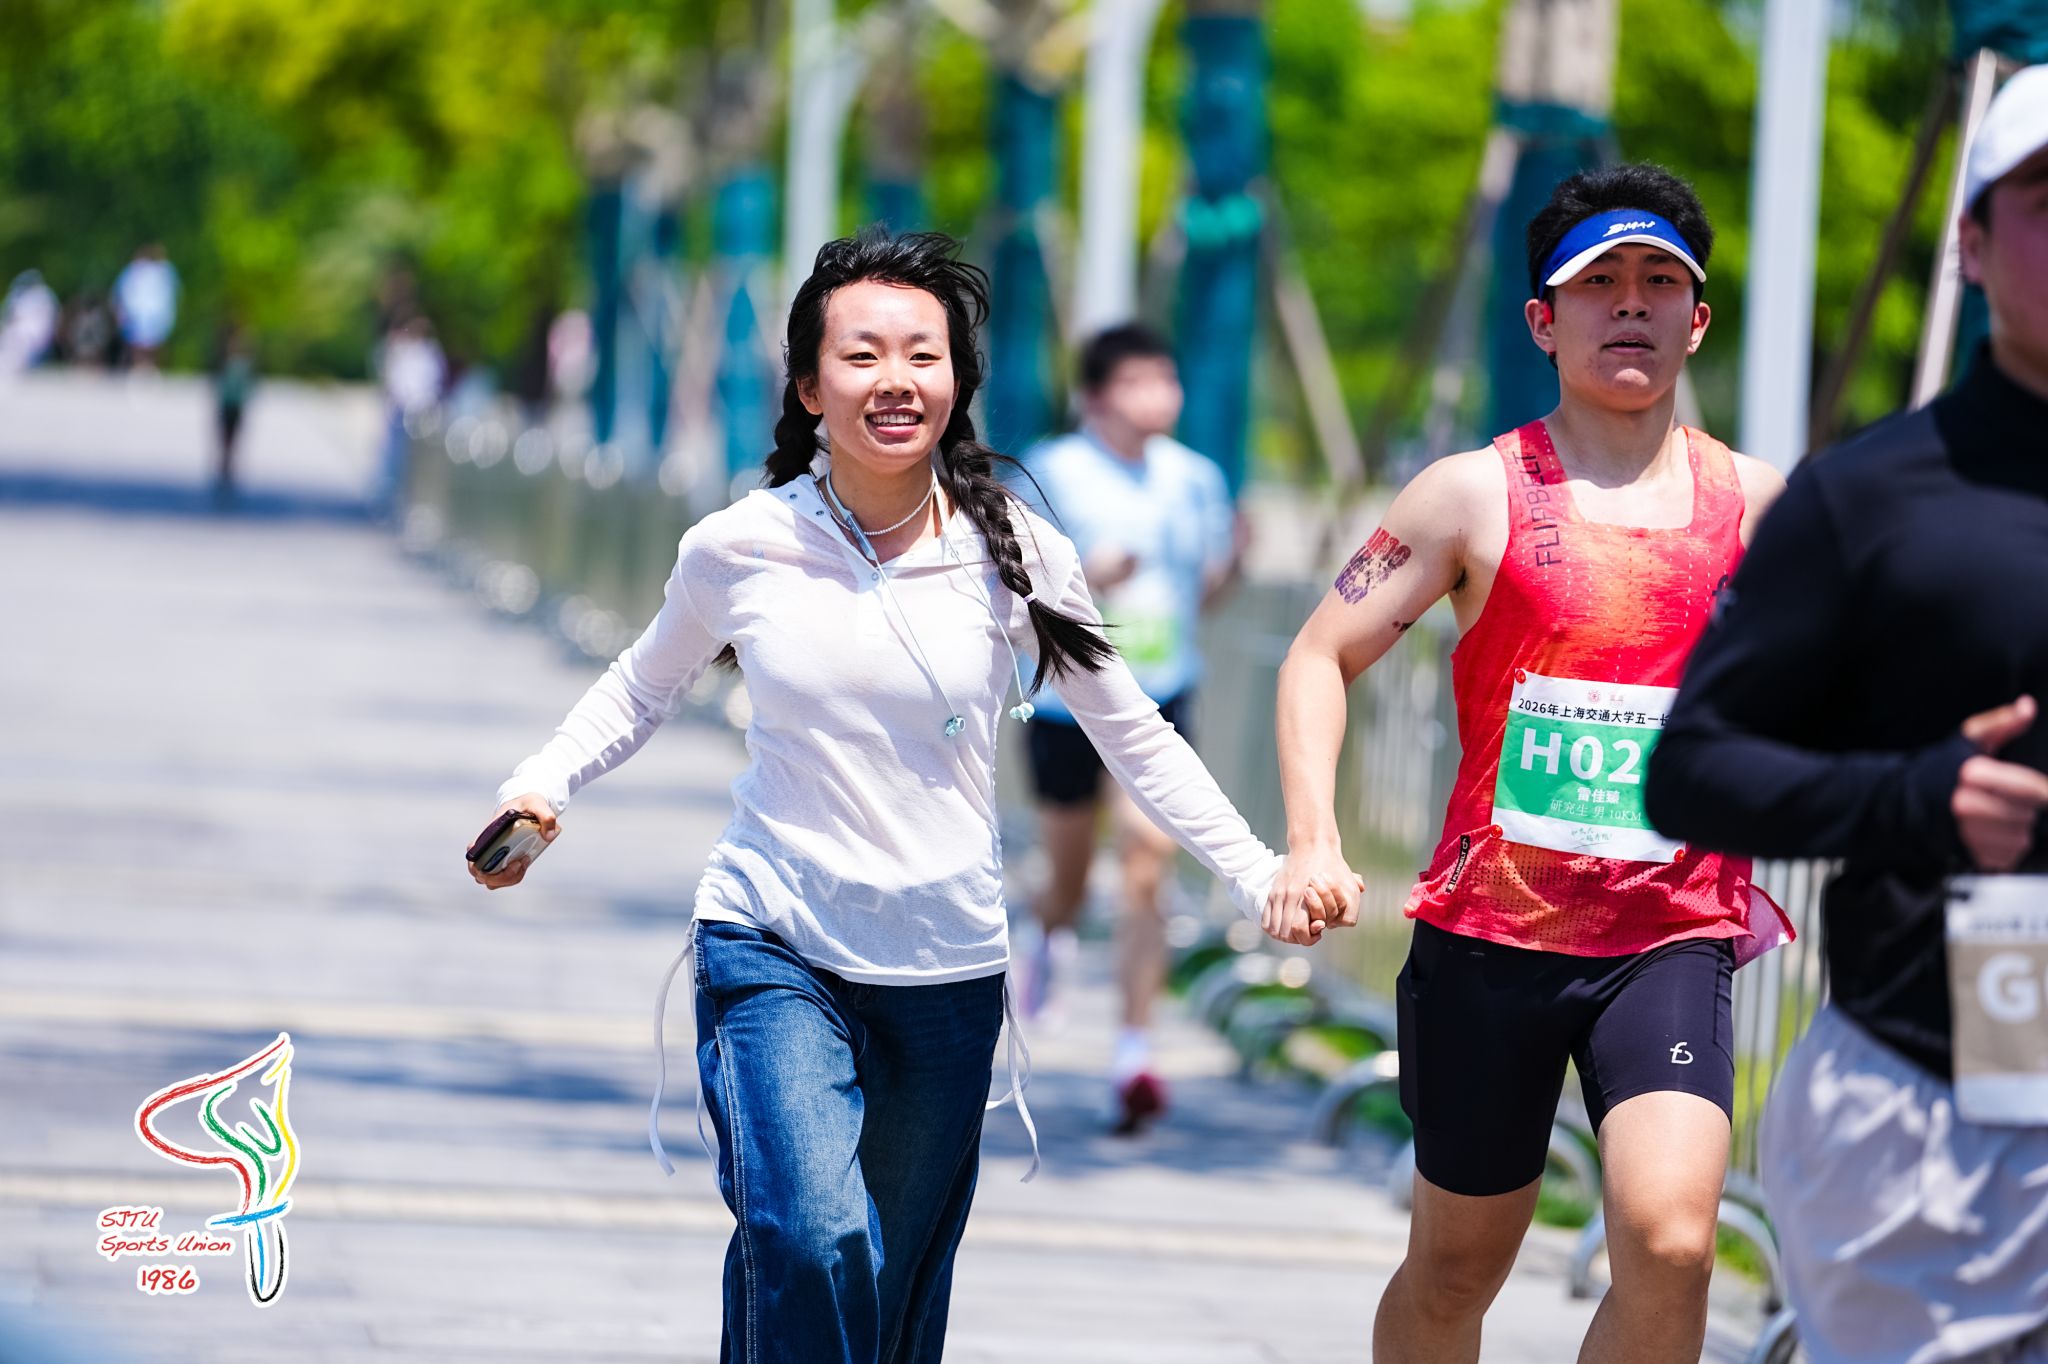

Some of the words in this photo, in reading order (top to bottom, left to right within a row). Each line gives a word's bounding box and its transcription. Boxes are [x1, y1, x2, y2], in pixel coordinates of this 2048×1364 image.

[1512, 451, 1562, 567] FLIPBELT
[1520, 727, 1642, 785] H02
[1977, 953, 2048, 1024] G
